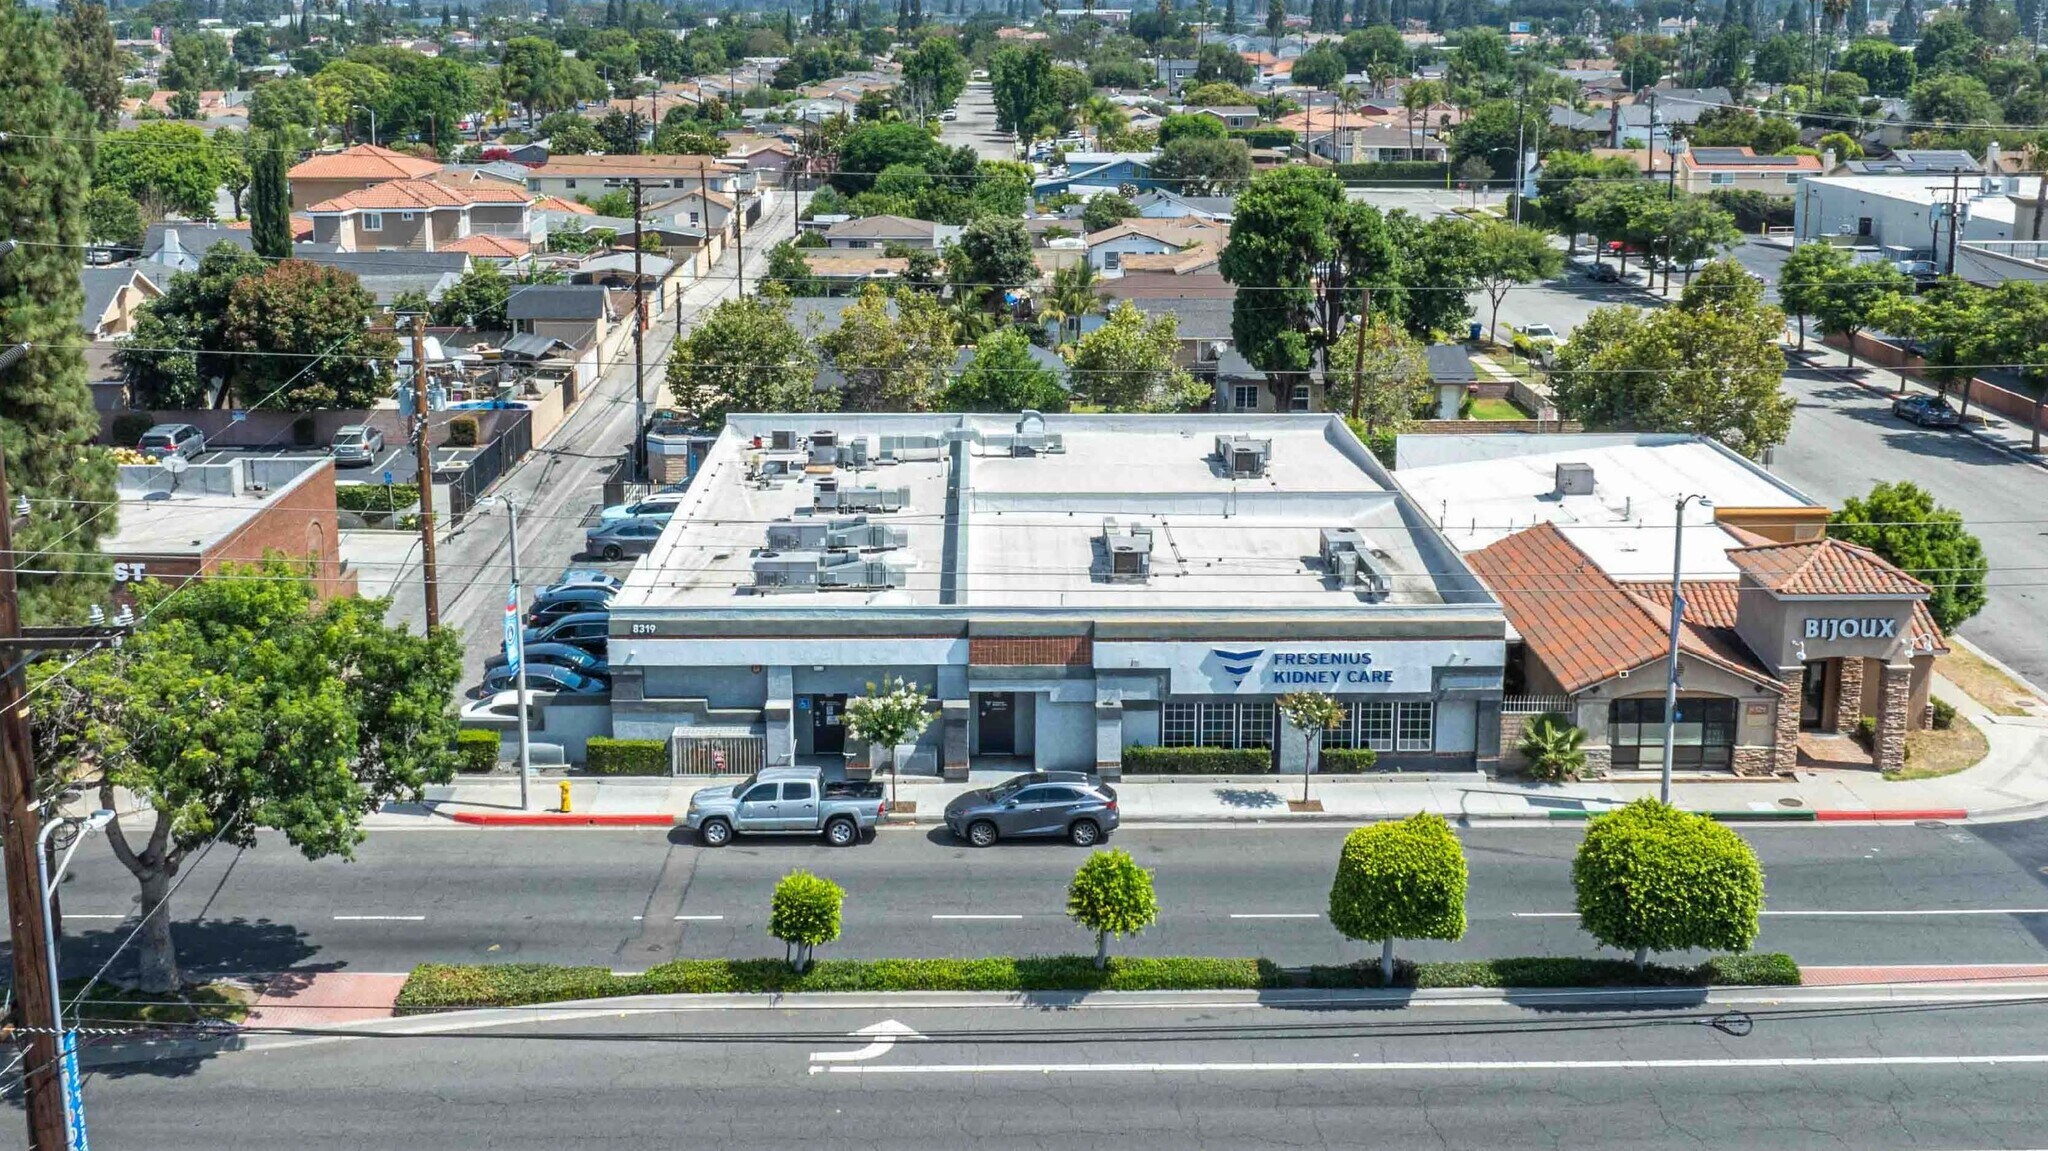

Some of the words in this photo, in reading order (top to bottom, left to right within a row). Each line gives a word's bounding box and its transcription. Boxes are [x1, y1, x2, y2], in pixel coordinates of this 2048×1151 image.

[632, 624, 656, 633] 8319
[1805, 619, 1895, 641] BIJOUX
[1274, 653, 1372, 665] FRESENIUS
[1274, 671, 1341, 683] KIDNEY
[1347, 670, 1394, 683] CARE
